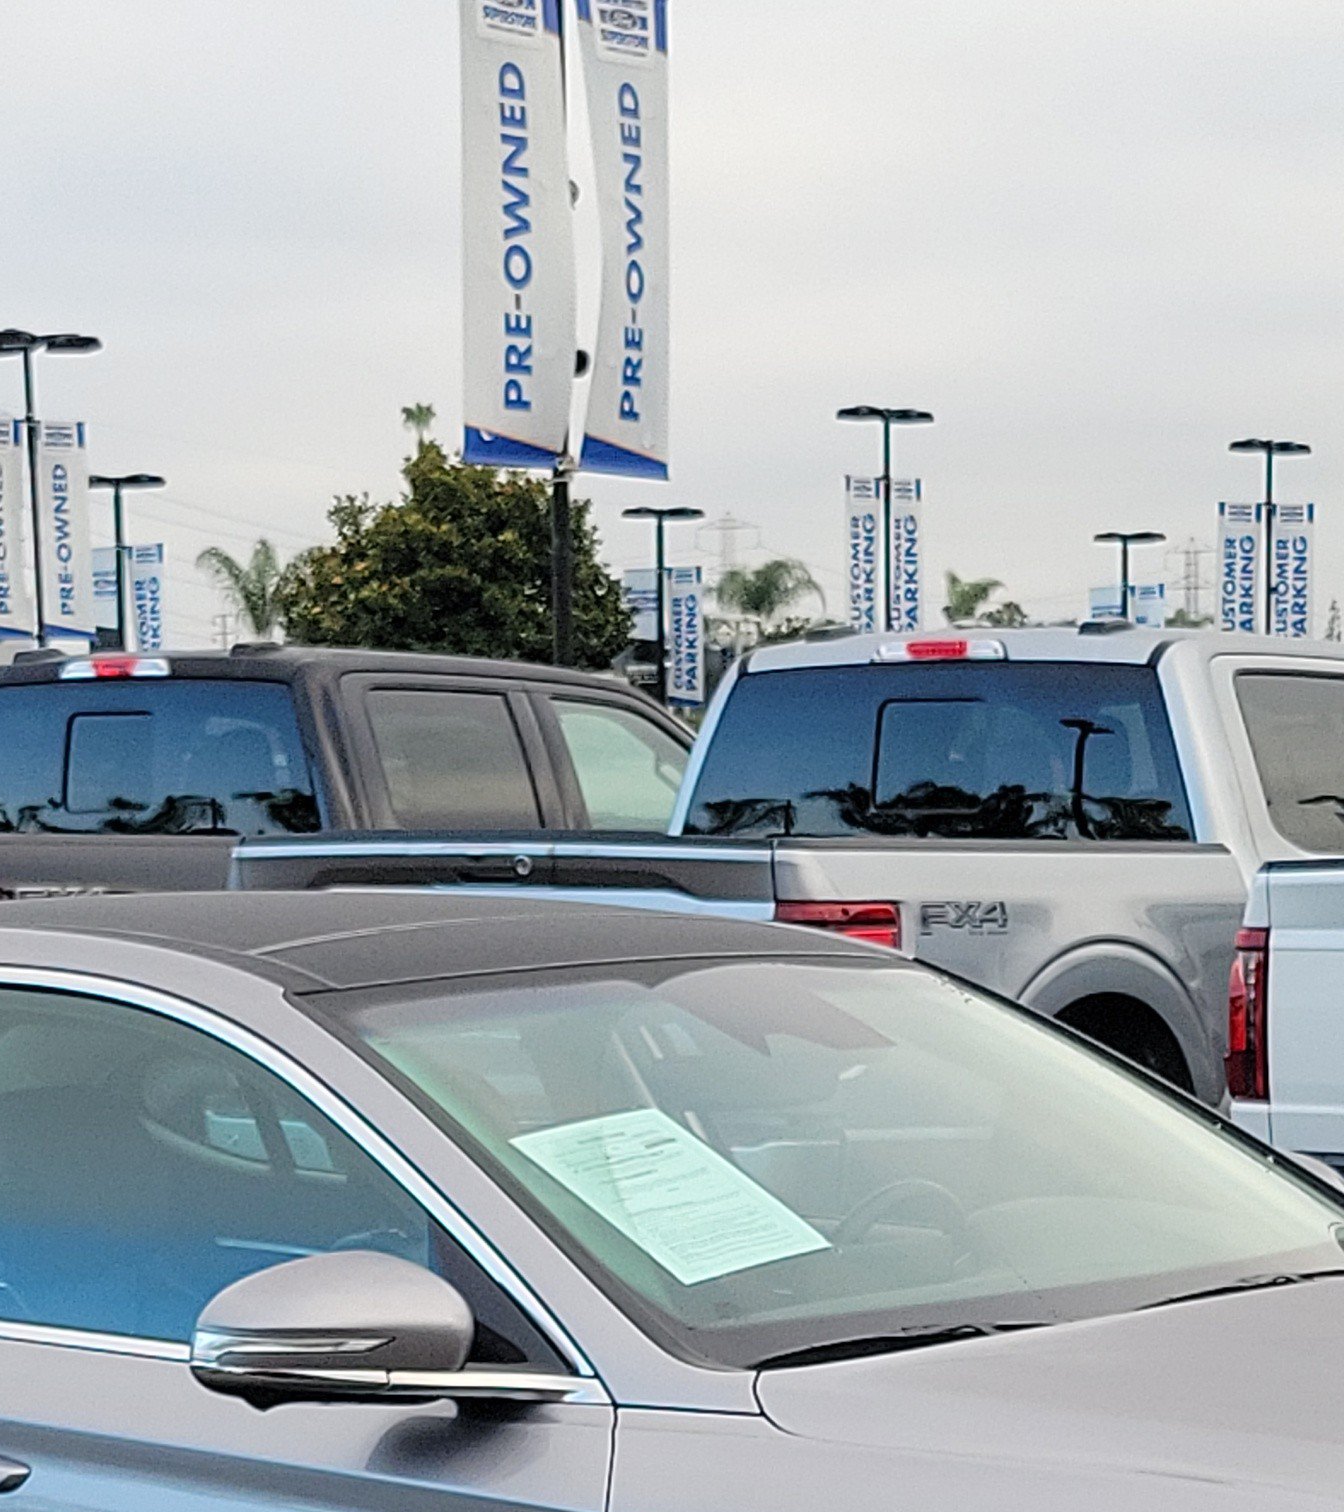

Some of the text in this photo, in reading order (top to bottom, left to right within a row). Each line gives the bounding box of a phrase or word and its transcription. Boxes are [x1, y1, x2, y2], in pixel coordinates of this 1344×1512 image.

[498, 60, 534, 413] PRE-OWNED
[617, 81, 645, 423] PRE-OWNED
[52, 463, 75, 616] PRE-OWNED
[1221, 537, 1237, 632] USTOMER
[1239, 535, 1255, 632] ARKING
[1275, 538, 1289, 633] USTOMER
[684, 593, 698, 691] PARKING
[920, 901, 1008, 936] FX4
